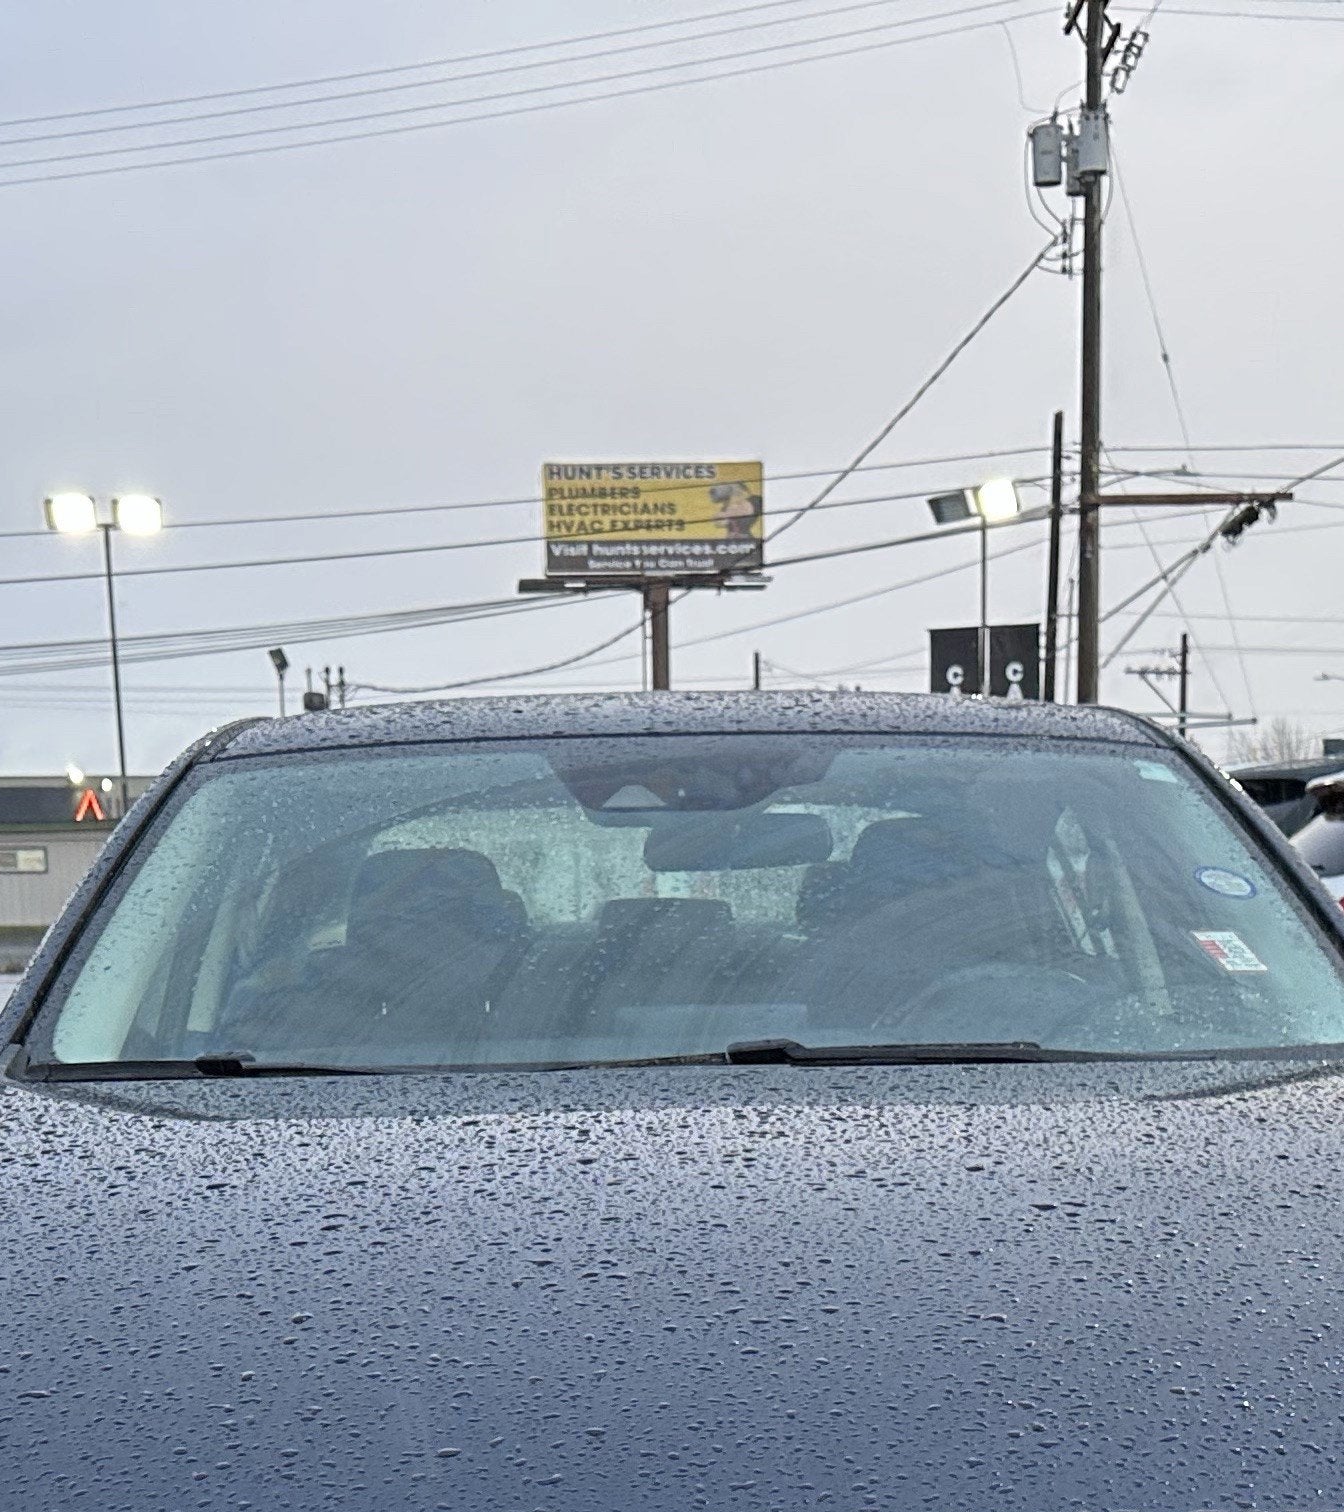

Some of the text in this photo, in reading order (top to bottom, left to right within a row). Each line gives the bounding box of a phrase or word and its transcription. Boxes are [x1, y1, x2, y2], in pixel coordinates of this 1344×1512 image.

[547, 463, 717, 480] HUNT'S SERVICES
[547, 486, 641, 500] PLUMBERS
[548, 502, 677, 516] ELECTRICIANS
[547, 519, 686, 534] HVAC EXPERTS
[550, 543, 588, 556] Visit
